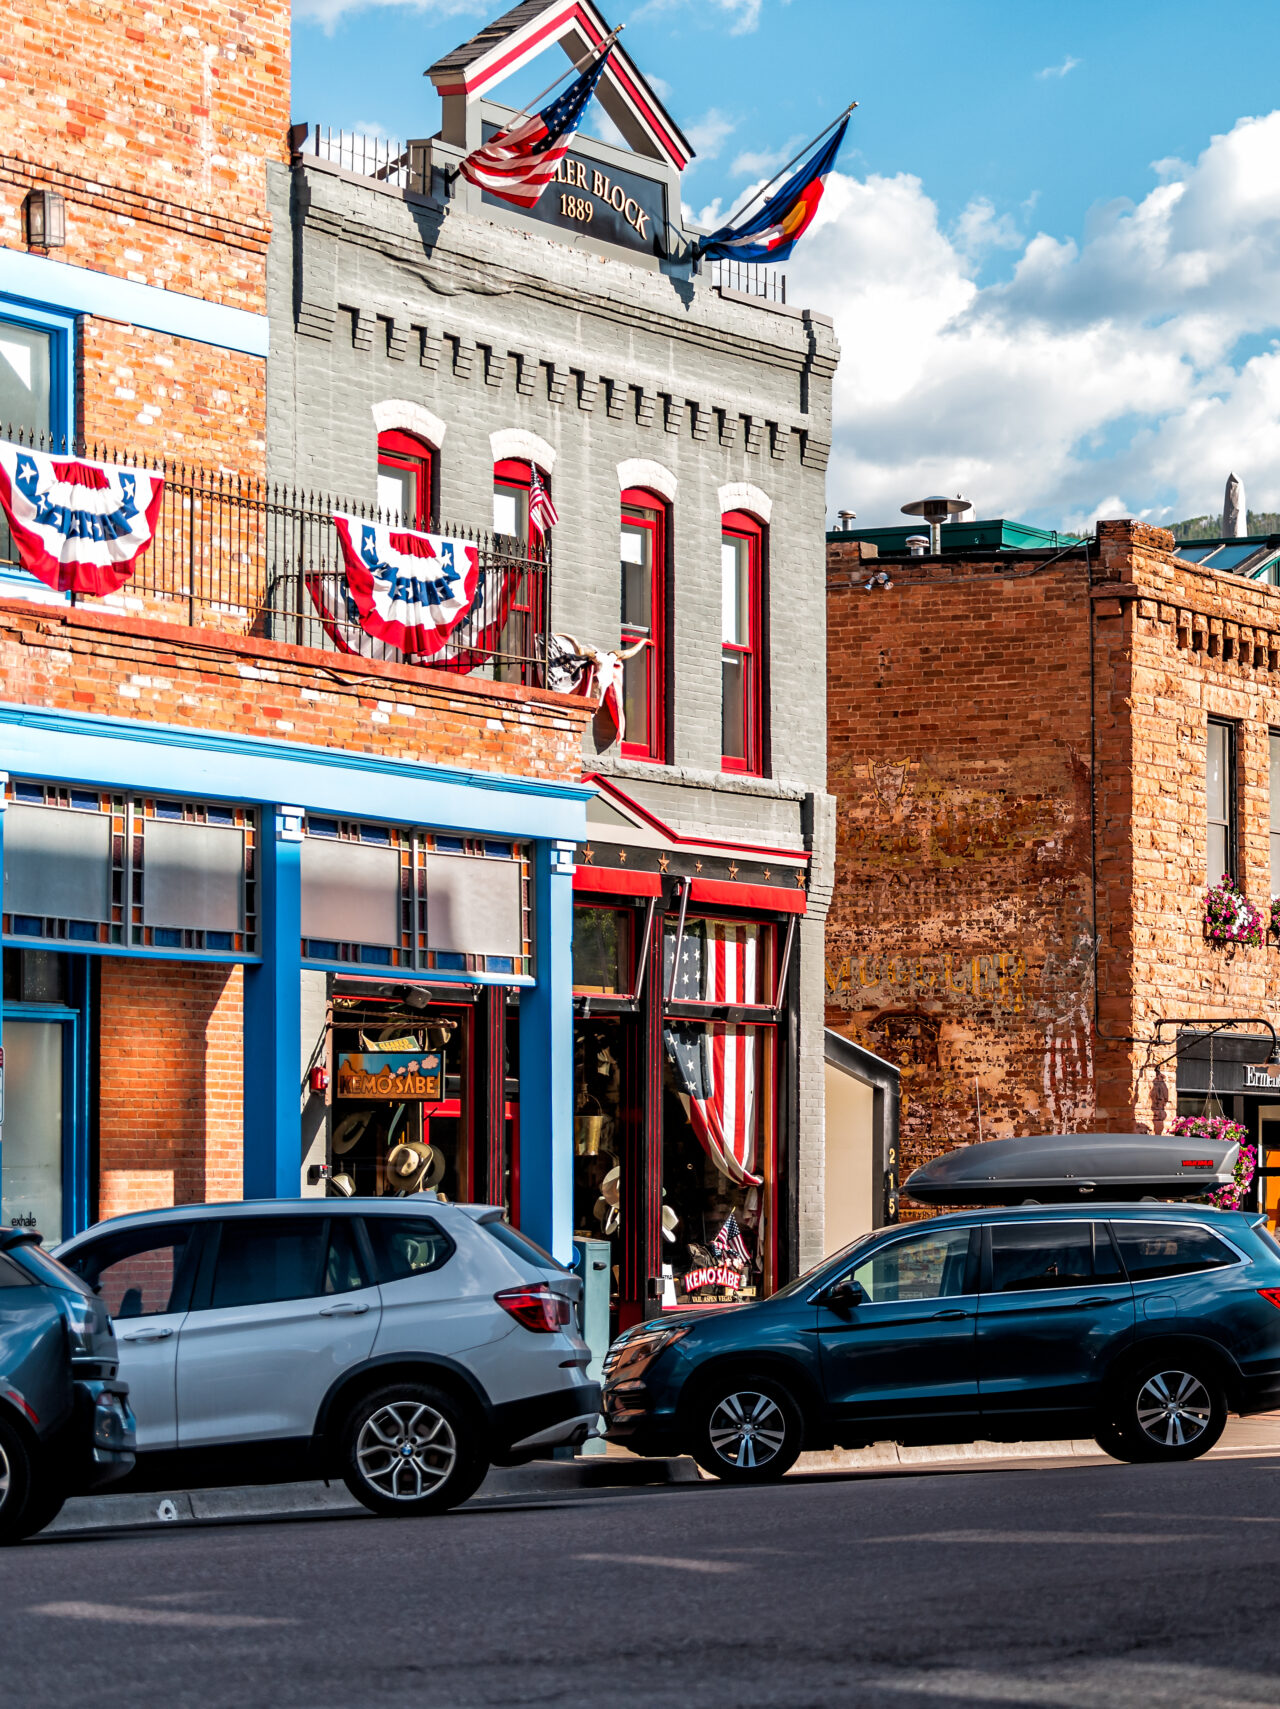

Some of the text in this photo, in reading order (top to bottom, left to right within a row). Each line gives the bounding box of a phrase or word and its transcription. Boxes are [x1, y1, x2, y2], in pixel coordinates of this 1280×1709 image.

[560, 193, 594, 223] 1889
[592, 169, 651, 241] BLOCK
[11, 1211, 37, 1227] exhale
